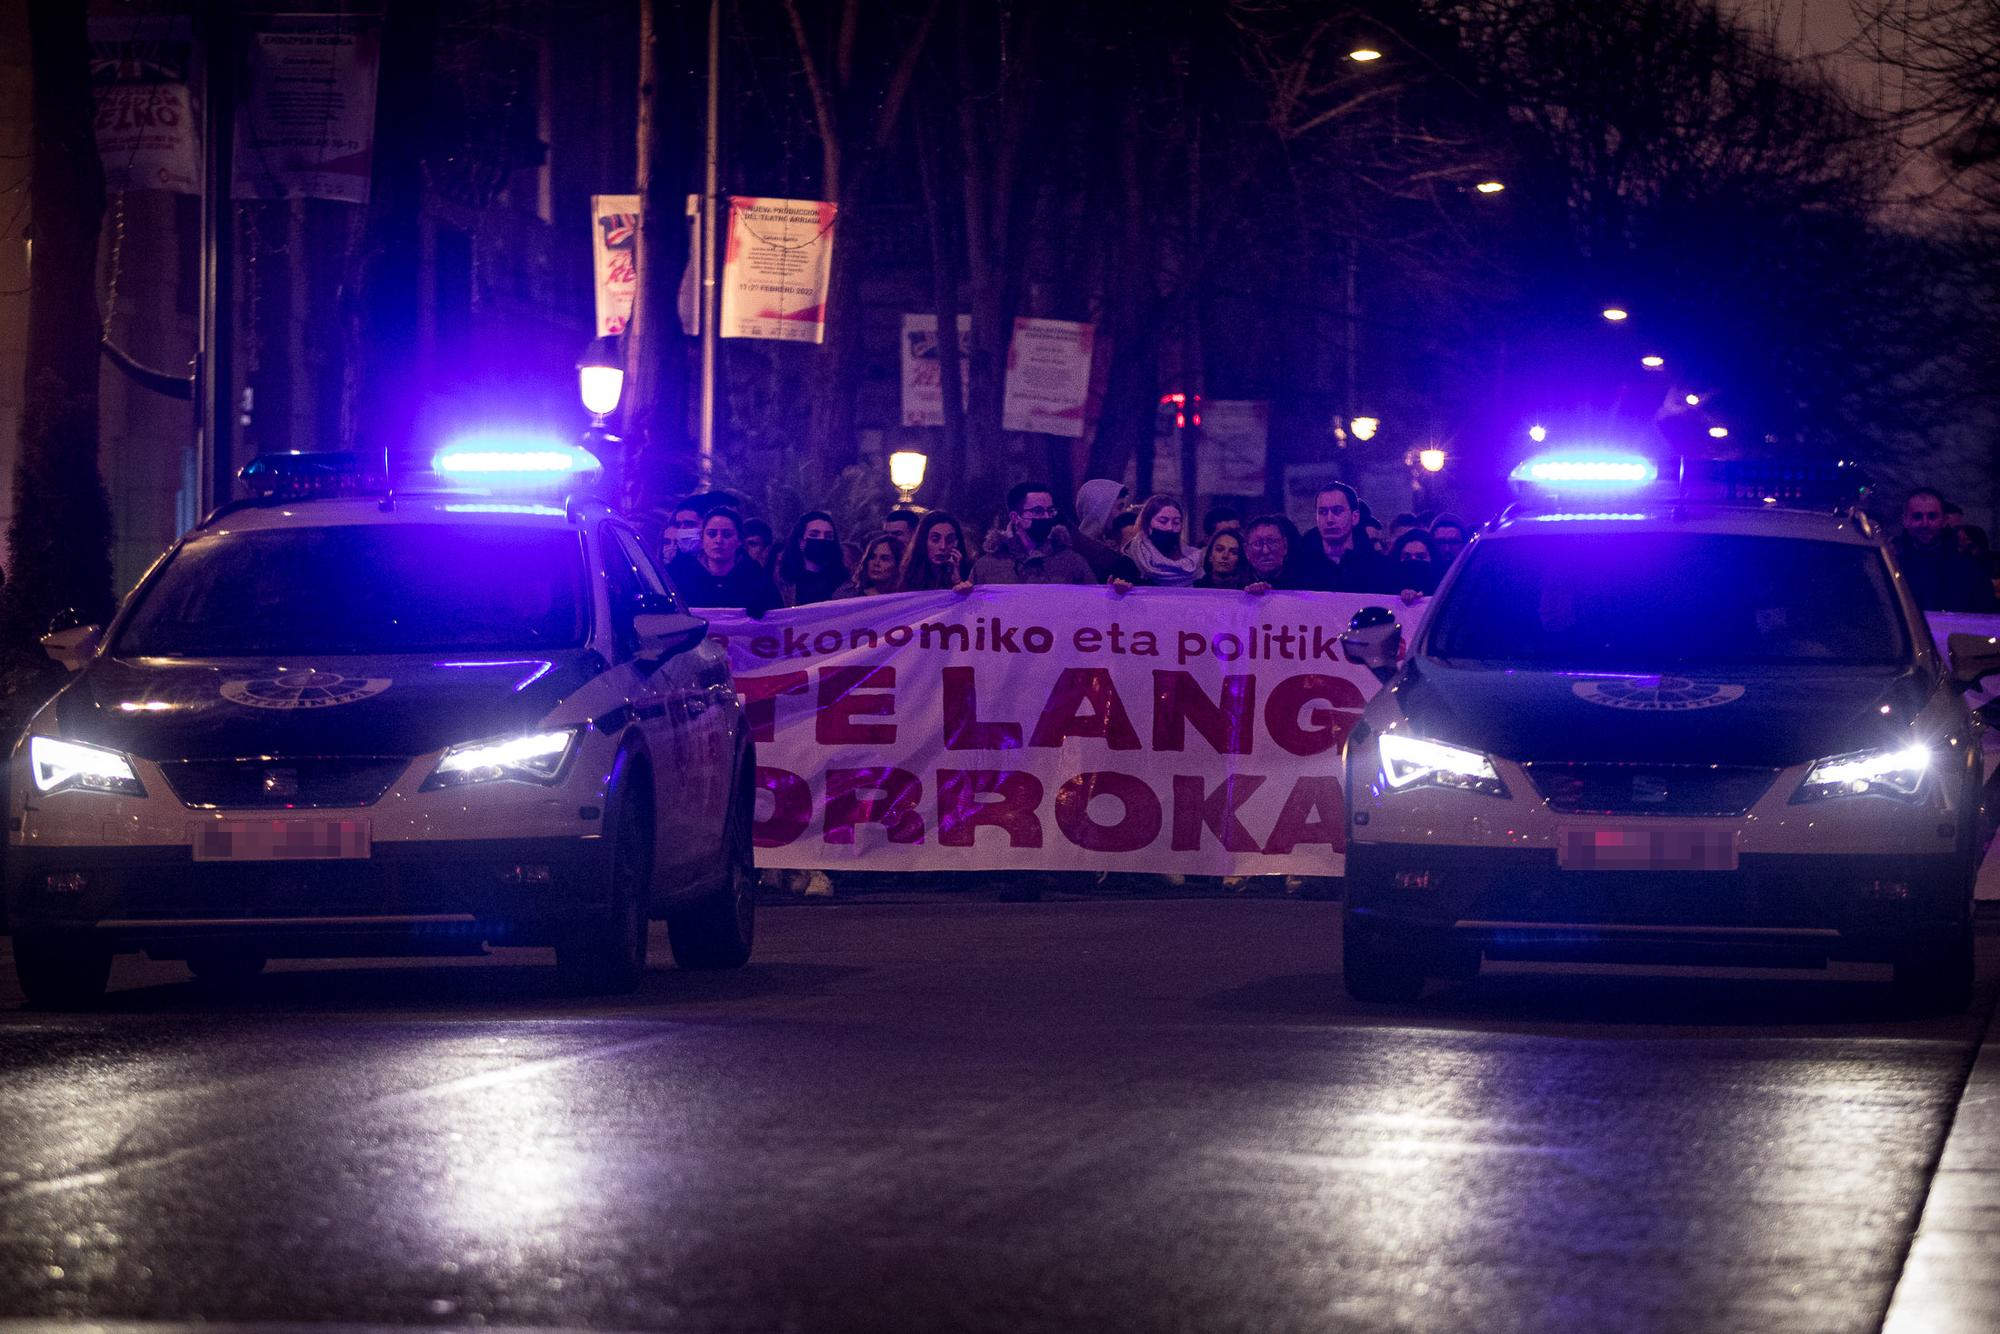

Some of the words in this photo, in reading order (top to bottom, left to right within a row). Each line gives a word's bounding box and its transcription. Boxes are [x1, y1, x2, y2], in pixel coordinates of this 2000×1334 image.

[751, 617, 1054, 659] ekonomiko
[1073, 623, 1158, 656] eta
[1178, 624, 1405, 665] politik
[942, 666, 1367, 756] LANG
